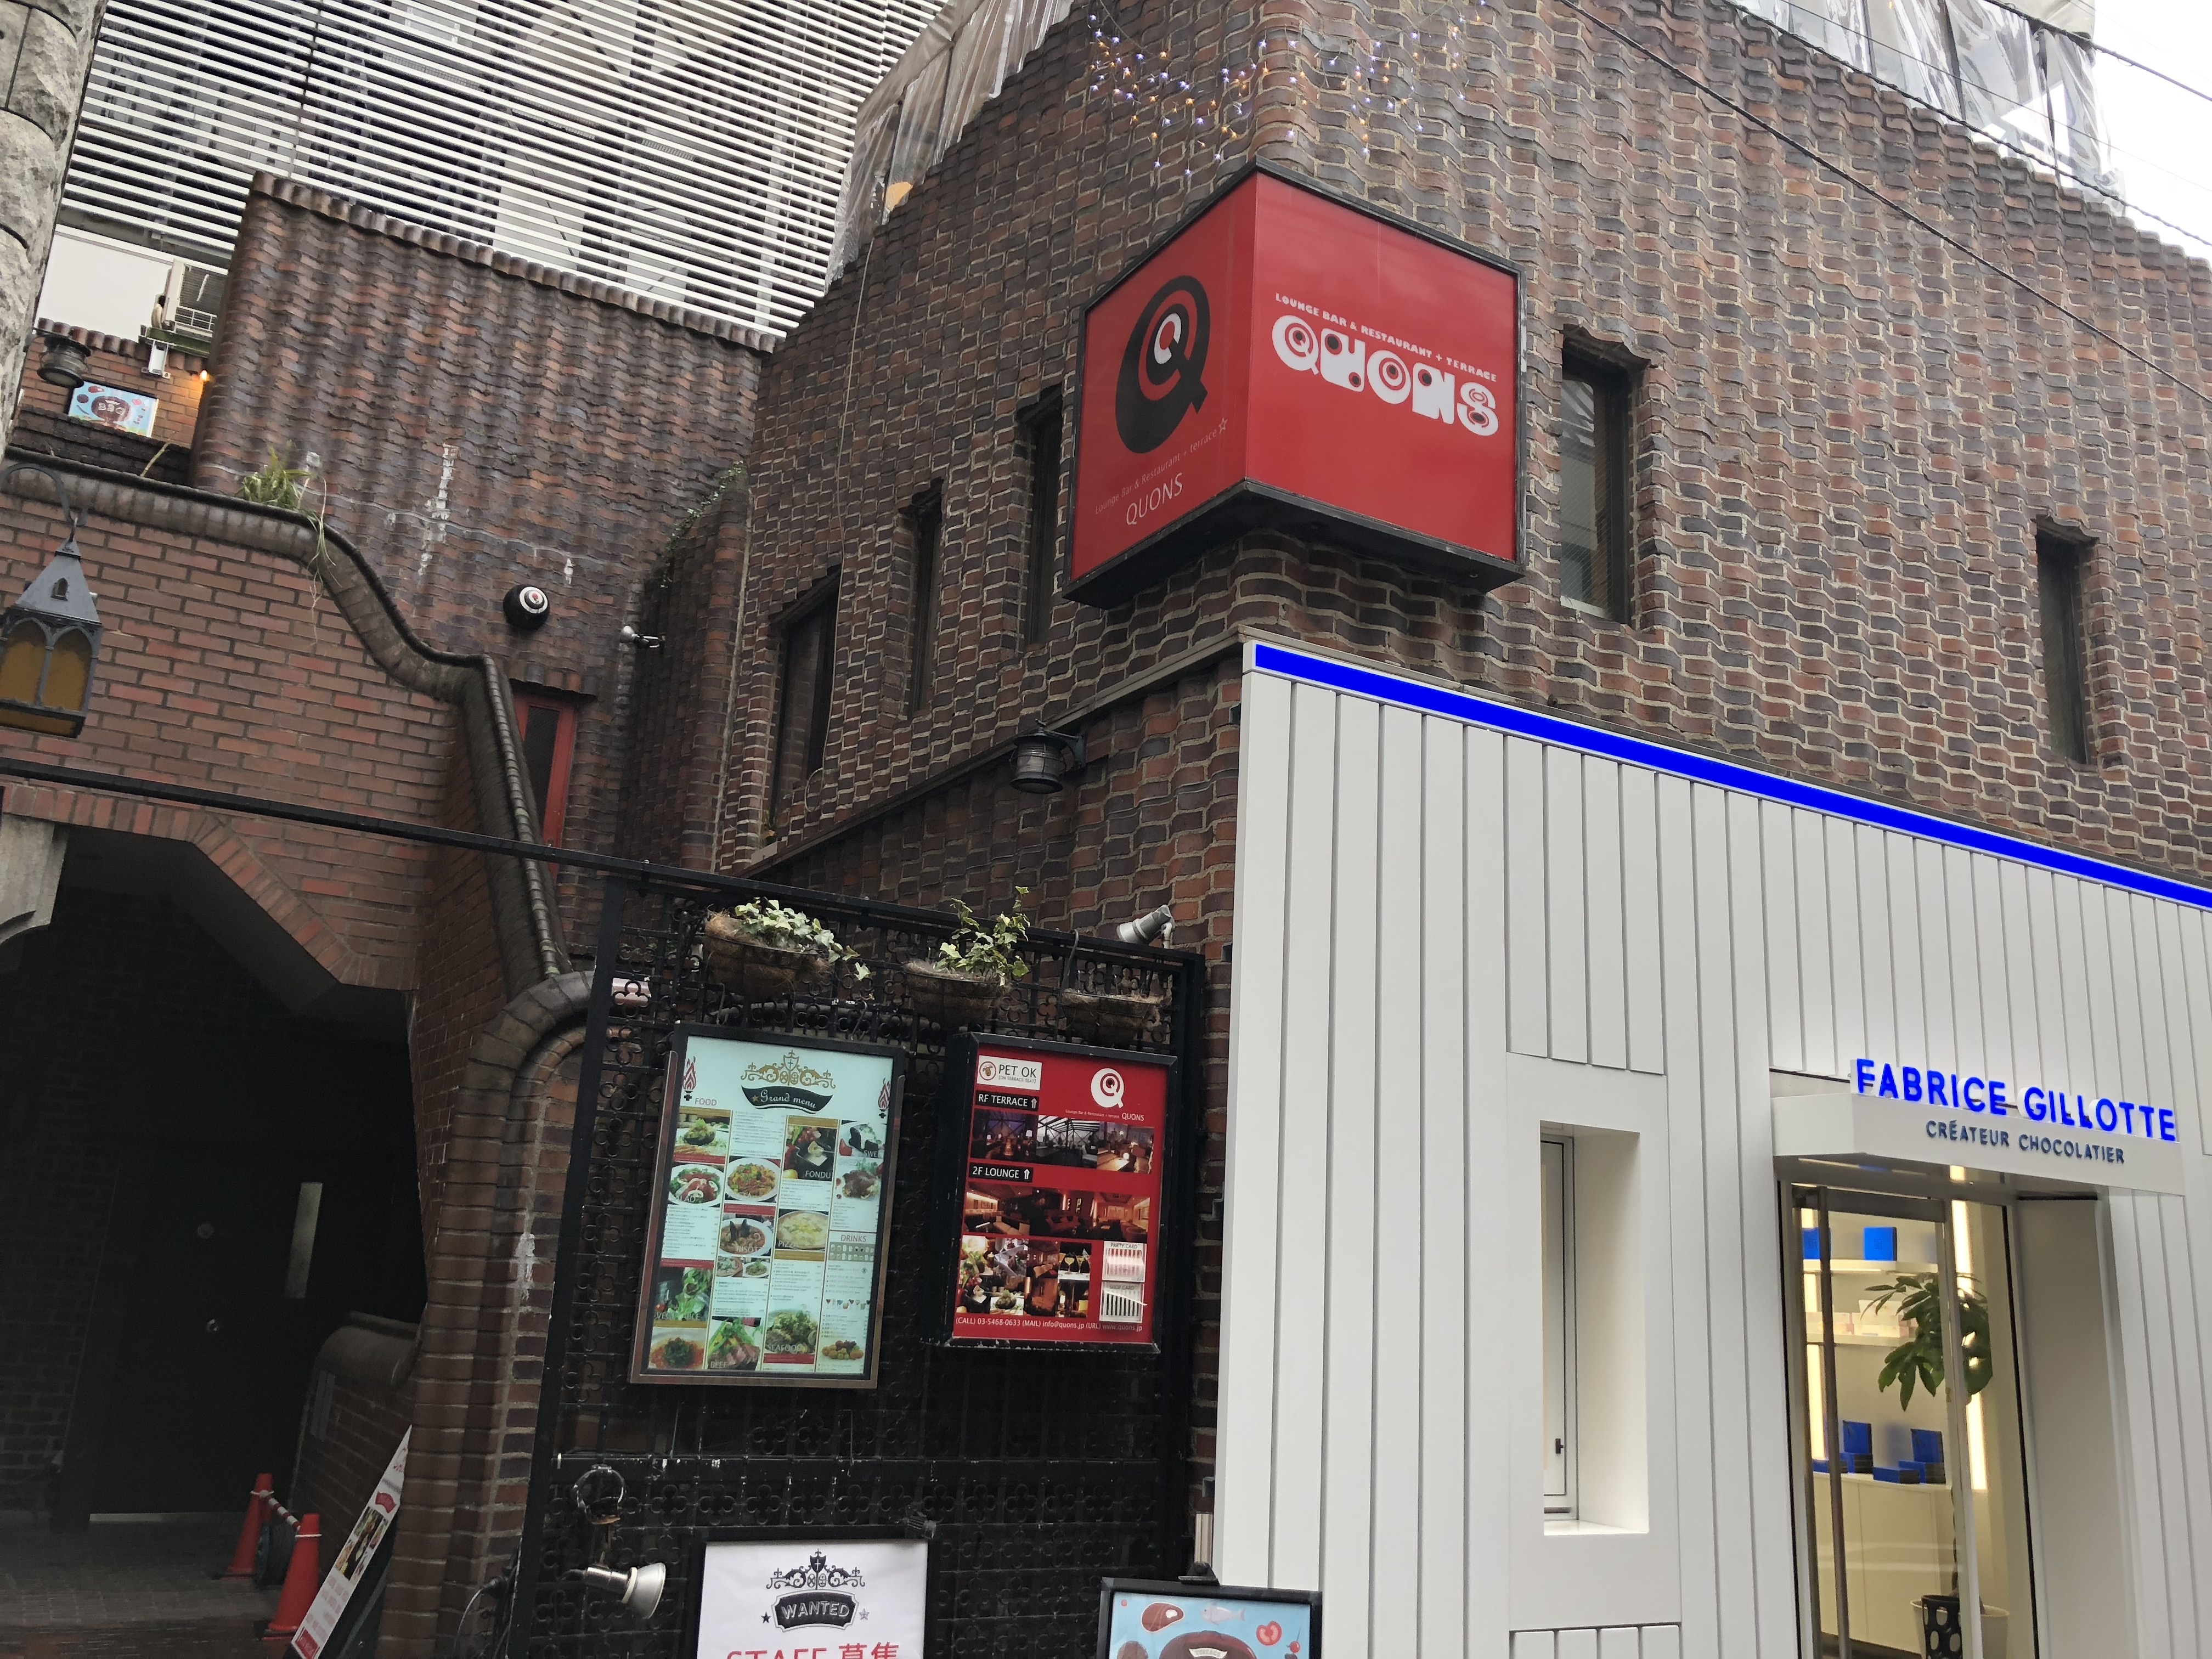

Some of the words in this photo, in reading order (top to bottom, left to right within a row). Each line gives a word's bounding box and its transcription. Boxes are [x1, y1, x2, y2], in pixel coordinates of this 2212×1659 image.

[1276, 292, 1319, 317] LOUNGE
[1323, 311, 1347, 326] BAR
[1350, 321, 1357, 330] &
[1361, 325, 1432, 359] RESTAURANT
[1446, 357, 1497, 382] TERRACE
[1272, 315, 1498, 436] QUONS
[1095, 494, 1119, 515] Lounge
[1121, 484, 1132, 498] Bar
[1135, 478, 1139, 489] &
[1142, 453, 1180, 484] Restaurant
[1190, 428, 1217, 453] terrace
[1126, 472, 1183, 525] QUONS
[998, 1064, 1018, 1076] PET
[1022, 1067, 1037, 1078] OK
[695, 1097, 717, 1106] FOOD
[760, 1089, 790, 1103] Grand
[793, 1097, 816, 1109] menu
[978, 1093, 989, 1102] RF
[991, 1095, 1028, 1107] TERRACE
[1857, 1058, 2007, 1116] FABRICE
[2023, 1086, 2177, 1142] GILLOTTE
[1121, 1112, 1144, 1121] QUONS
[1926, 1120, 2010, 1148] CRÉATEUR
[2019, 1133, 2125, 1164] CHOCOLATIER
[805, 1170, 832, 1179] FONDU
[972, 1166, 983, 1175] 2F
[985, 1167, 1019, 1178] LOUNGE
[841, 1234, 867, 1243] DRINKS
[1043, 1320, 1085, 1330] info@quons.jp
[1102, 1324, 1143, 1332] www.quons.jp
[781, 1600, 850, 1620] WANTED
